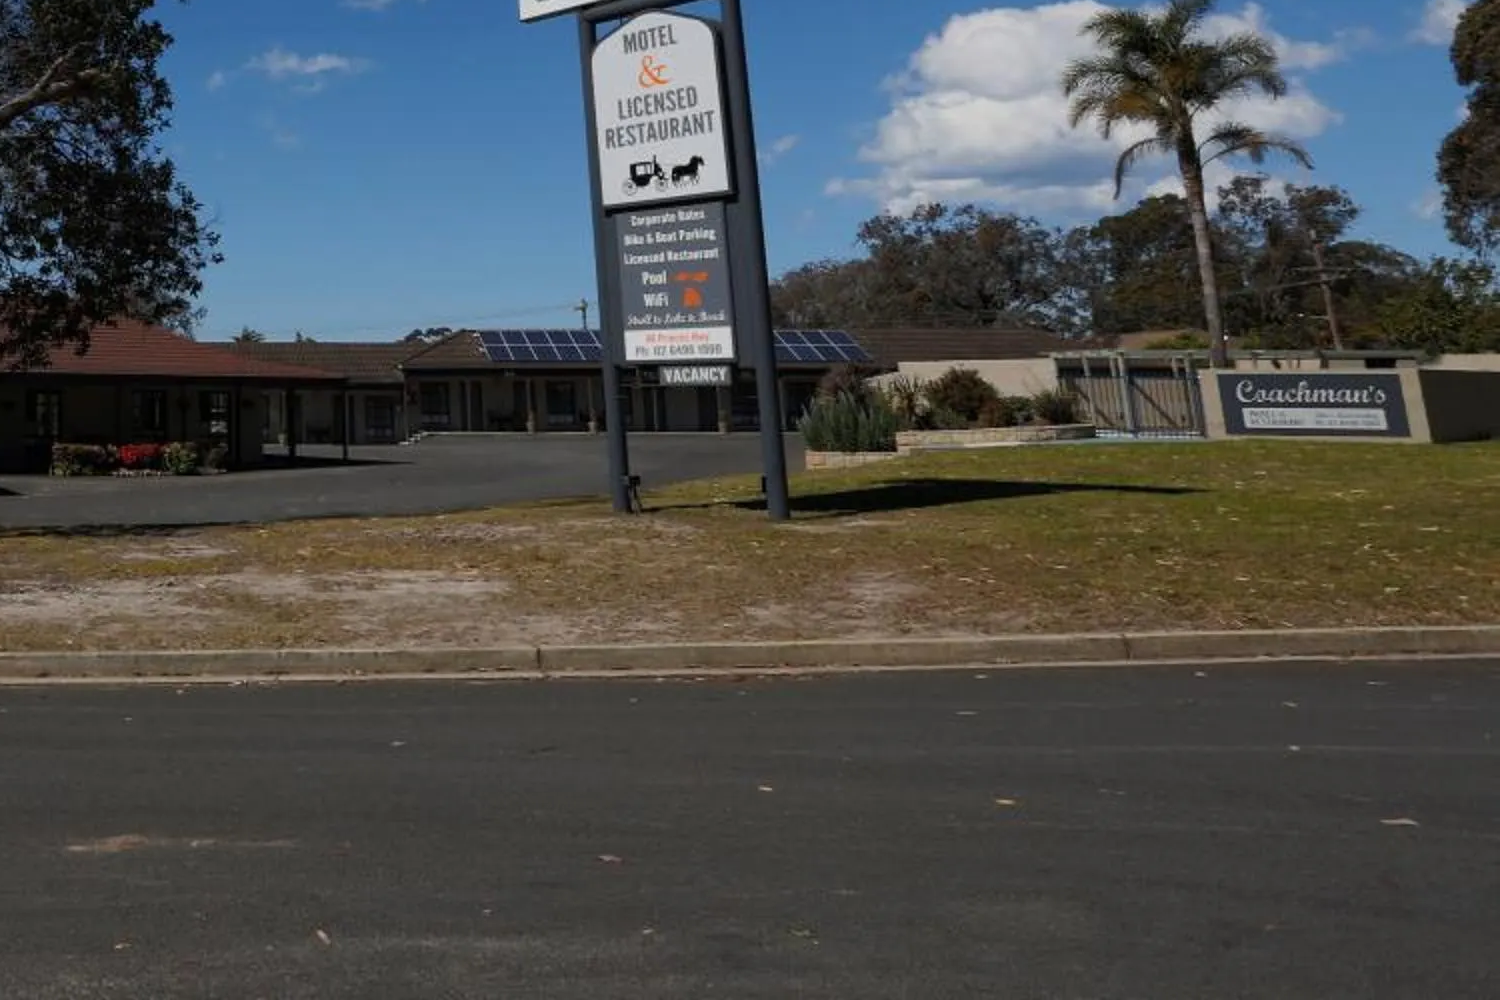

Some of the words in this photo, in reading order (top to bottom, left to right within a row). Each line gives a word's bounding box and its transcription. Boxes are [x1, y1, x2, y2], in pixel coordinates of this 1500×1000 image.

[623, 24, 677, 54] MOTEL
[638, 55, 672, 88] &
[617, 85, 698, 120] LICENSED
[605, 111, 716, 149] RESTAURANT
[631, 212, 676, 228] Corporate
[678, 210, 705, 221] Rates
[679, 227, 717, 241] Parking
[624, 252, 665, 265] Licensed
[667, 248, 719, 262] Restaurant
[642, 270, 667, 285] Pool
[663, 366, 727, 383] VACANCY
[1236, 379, 1386, 404] Coachman's
